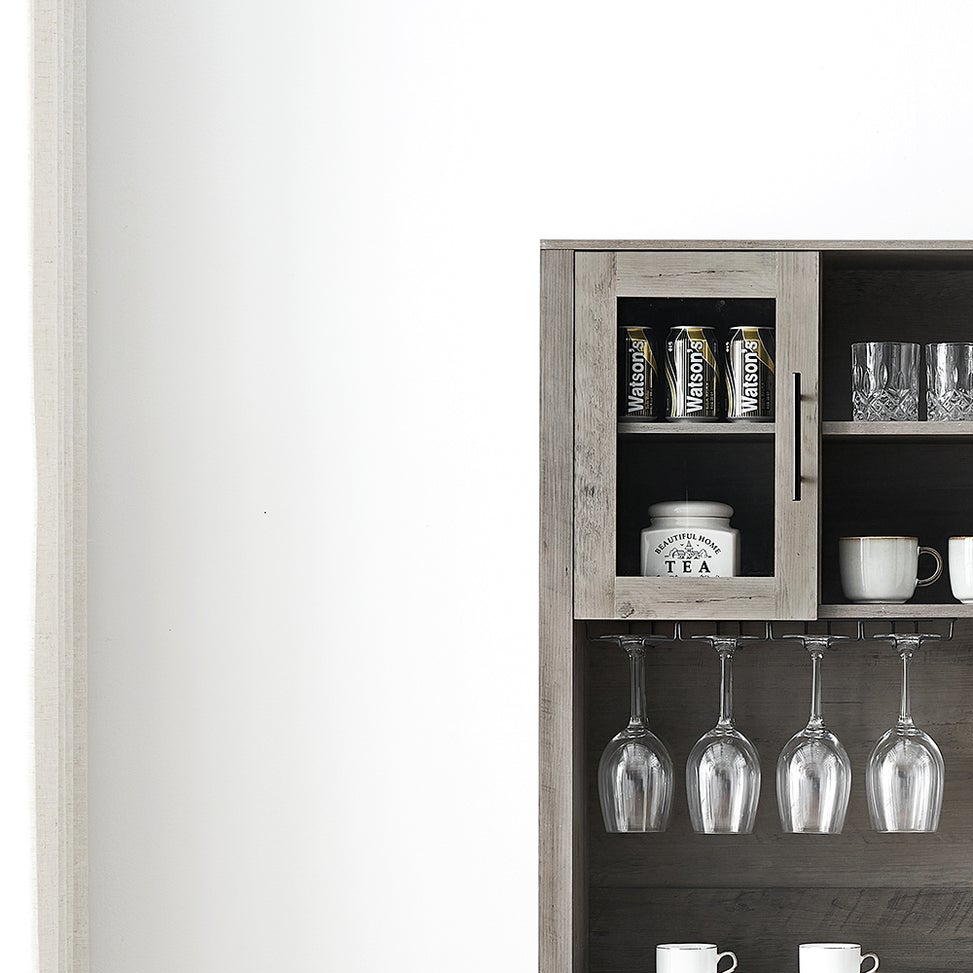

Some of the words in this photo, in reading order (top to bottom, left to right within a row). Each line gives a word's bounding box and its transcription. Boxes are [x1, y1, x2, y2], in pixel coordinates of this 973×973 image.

[628, 340, 645, 413] Watson's
[686, 340, 703, 414] Watson's
[741, 340, 758, 414] Watson's
[655, 533, 697, 555] BEAUTIFUL
[698, 535, 721, 555] HOME
[665, 560, 711, 573] TEA
